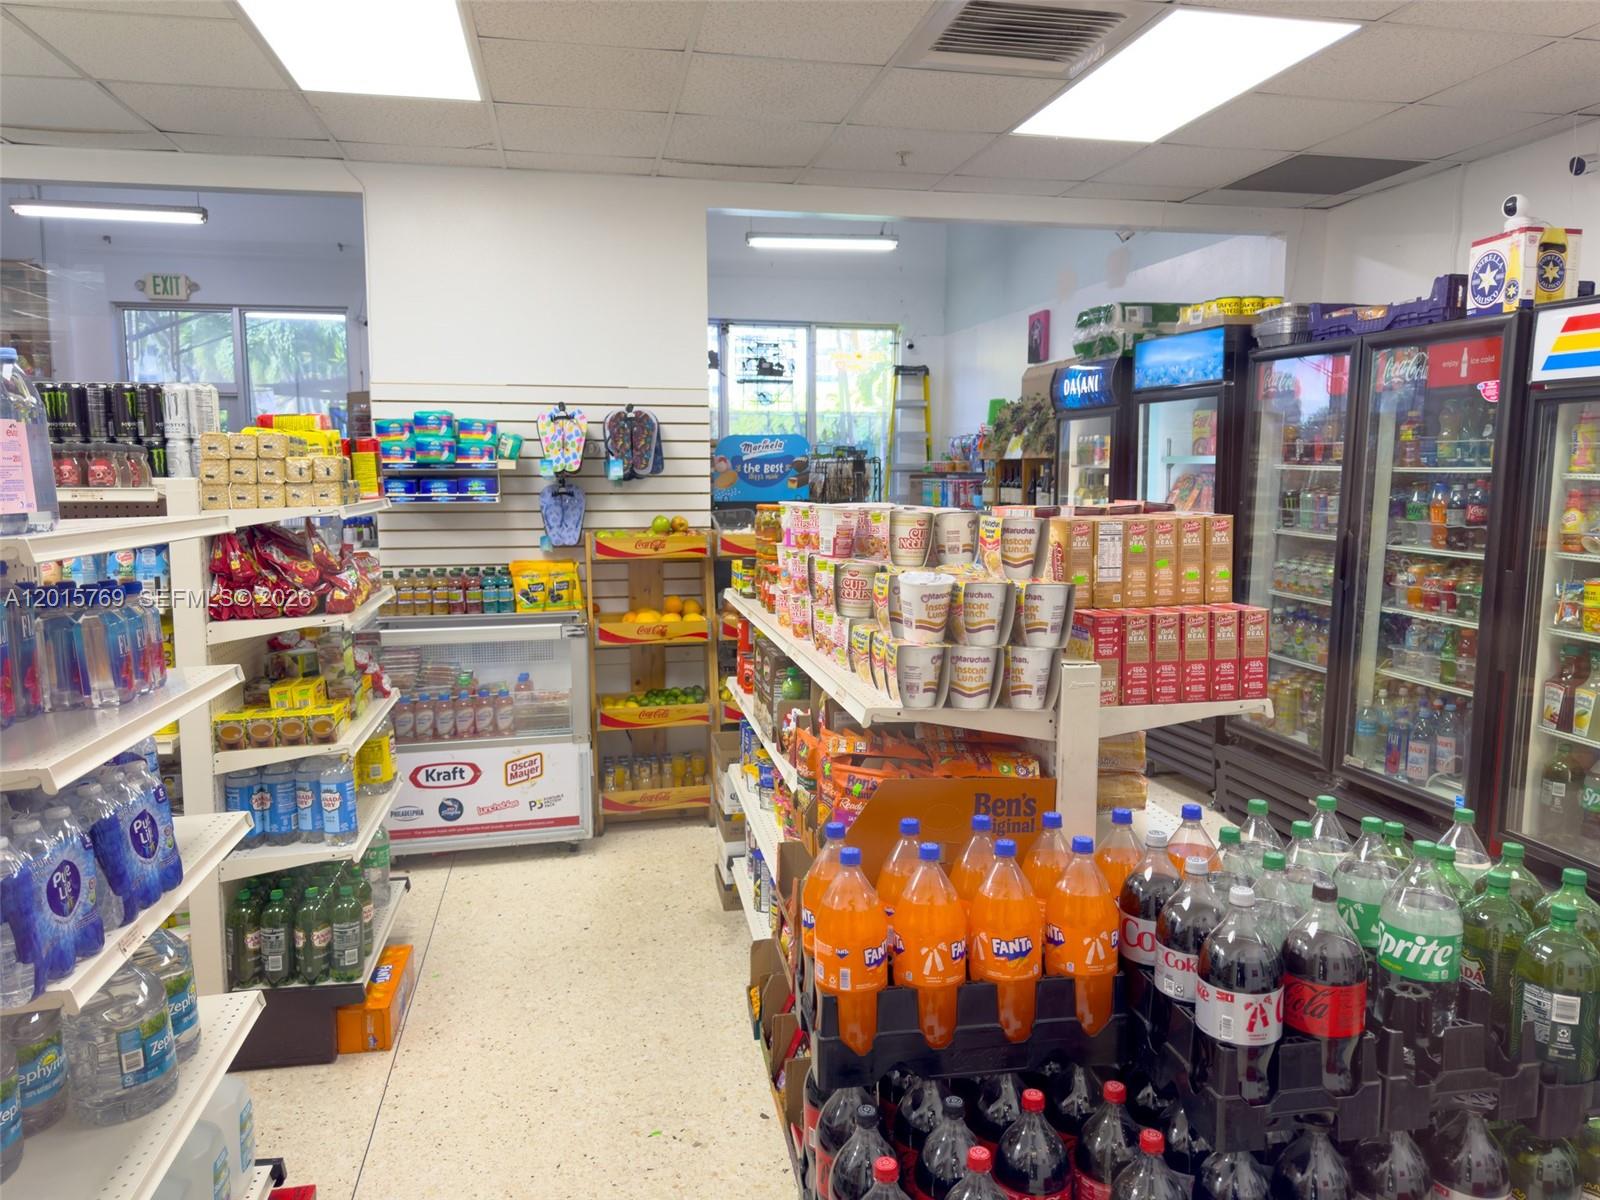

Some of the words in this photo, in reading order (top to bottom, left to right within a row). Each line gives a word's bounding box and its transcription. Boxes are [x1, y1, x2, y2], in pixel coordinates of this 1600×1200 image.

[1474, 253, 1503, 274] ESTRELLA
[152, 275, 181, 297] EXIT
[1474, 290, 1499, 304] JALISCO
[1442, 360, 1458, 369] enjoy
[1480, 355, 1495, 363] cold
[1064, 373, 1099, 398] DASANI
[741, 439, 784, 453] Marinela
[743, 463, 761, 474] the
[763, 463, 784, 474] Best
[635, 540, 666, 550] Coca-Cola
[842, 578, 868, 589] CUP
[928, 590, 950, 601] Maruch
[964, 591, 994, 599] ruchan
[925, 603, 948, 612] Insta
[965, 602, 989, 610] stant
[636, 625, 668, 636] Coca-Cola
[954, 665, 987, 674] Instant
[957, 674, 985, 683] Lunch
[638, 710, 670, 719] Coca-Cola
[511, 758, 538, 772] Oscar
[425, 766, 466, 782] Kraft
[509, 765, 540, 782] Mayer
[158, 789, 164, 797] 6
[974, 793, 1037, 817] Ben's
[390, 808, 424, 818] PHILADELPHIA
[992, 818, 1036, 836] iginal
[802, 908, 815, 924] NTA
[1122, 918, 1155, 952] Co
[864, 938, 888, 964] FAN
[951, 940, 966, 958] FAN
[992, 937, 1033, 955] FANTA
[1379, 921, 1453, 967] Sprite
[168, 992, 197, 1016] Zephy
[151, 1031, 174, 1056] Zeph
